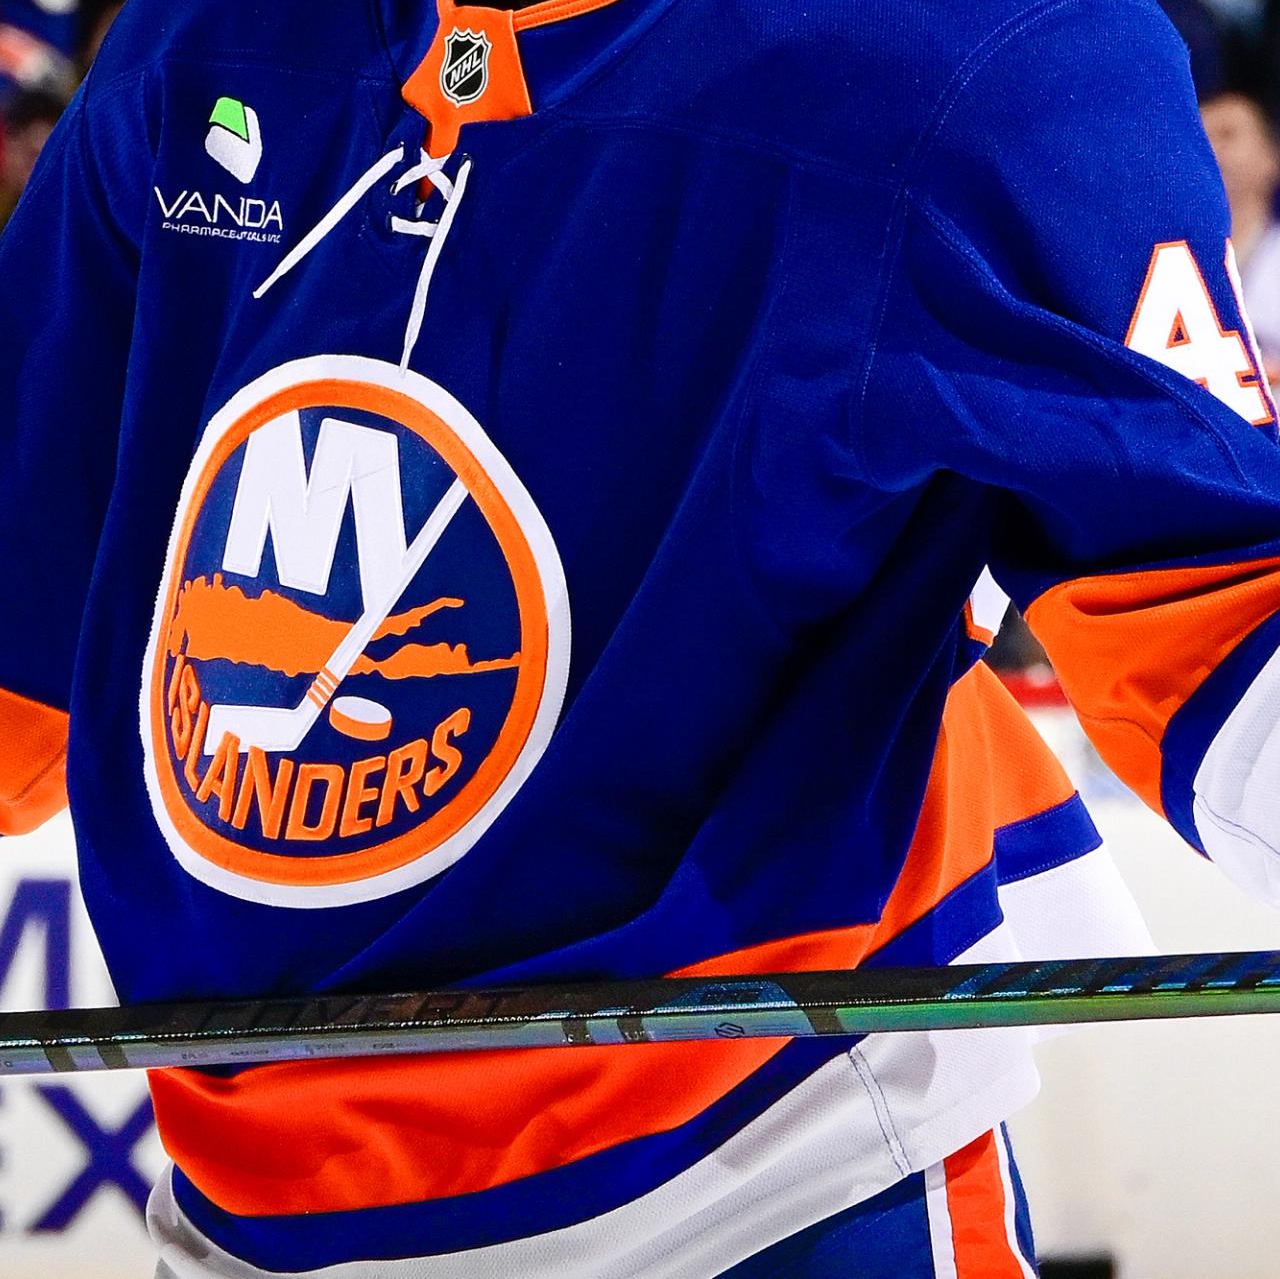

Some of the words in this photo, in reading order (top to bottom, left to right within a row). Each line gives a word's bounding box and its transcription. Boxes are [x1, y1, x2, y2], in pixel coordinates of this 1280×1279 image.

[449, 49, 482, 88] NHL
[154, 186, 283, 230] VANDA
[169, 655, 471, 842] ISLANDERS
